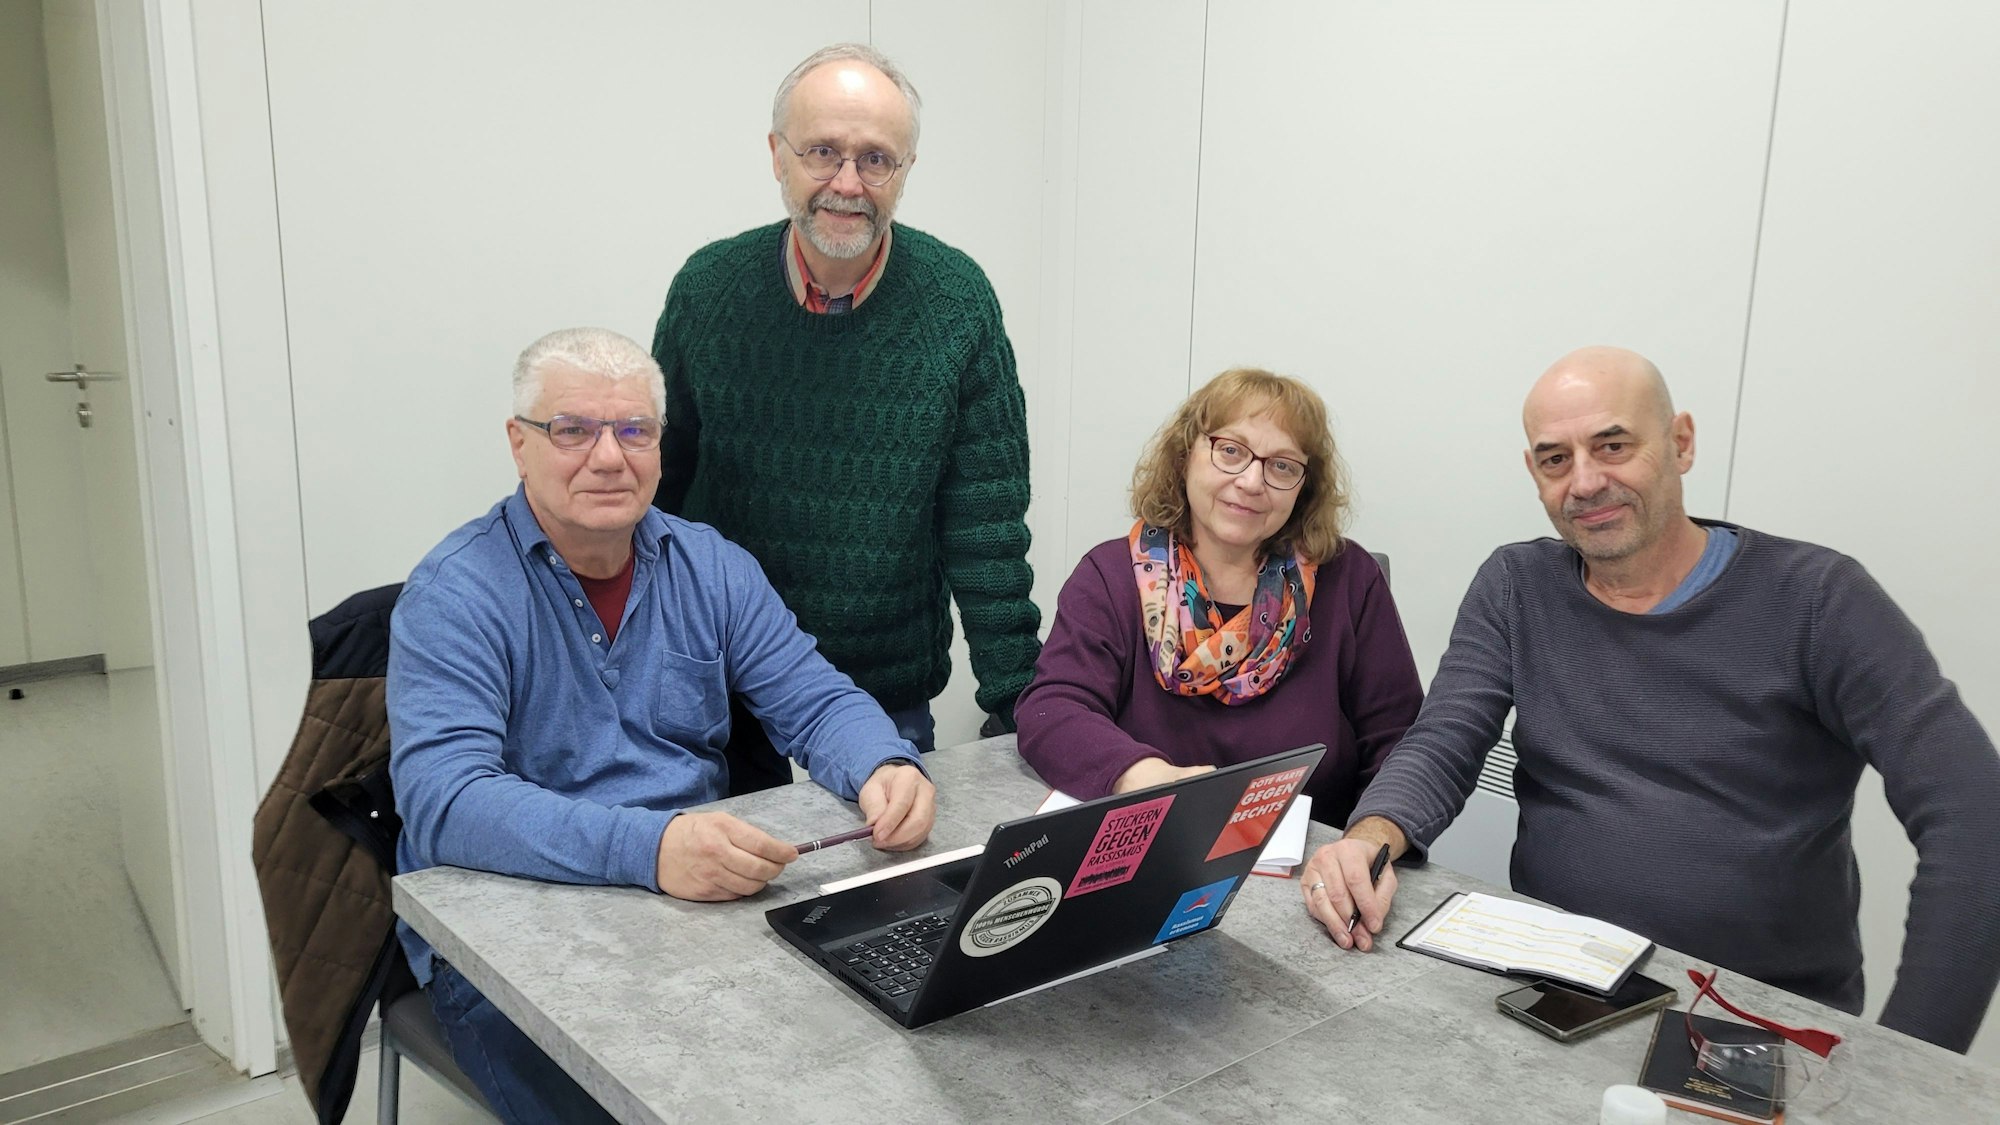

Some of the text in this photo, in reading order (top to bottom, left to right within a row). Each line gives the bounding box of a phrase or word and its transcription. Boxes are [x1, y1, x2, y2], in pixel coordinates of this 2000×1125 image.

[1249, 768, 1308, 790] ROTE KARTE
[1240, 780, 1298, 806] GEGEN
[1104, 807, 1163, 833] STICKERN
[1229, 800, 1287, 824] RECHTS
[1094, 822, 1155, 854] GEGEN
[1003, 834, 1049, 868] ThinkPad
[1087, 843, 1145, 867] RASSISMUS
[1003, 890, 1041, 906] ZUSAMMEN
[975, 905, 1049, 930] 100% MENSCHENWÜRDE
[993, 918, 1036, 942] RASSISMUS
